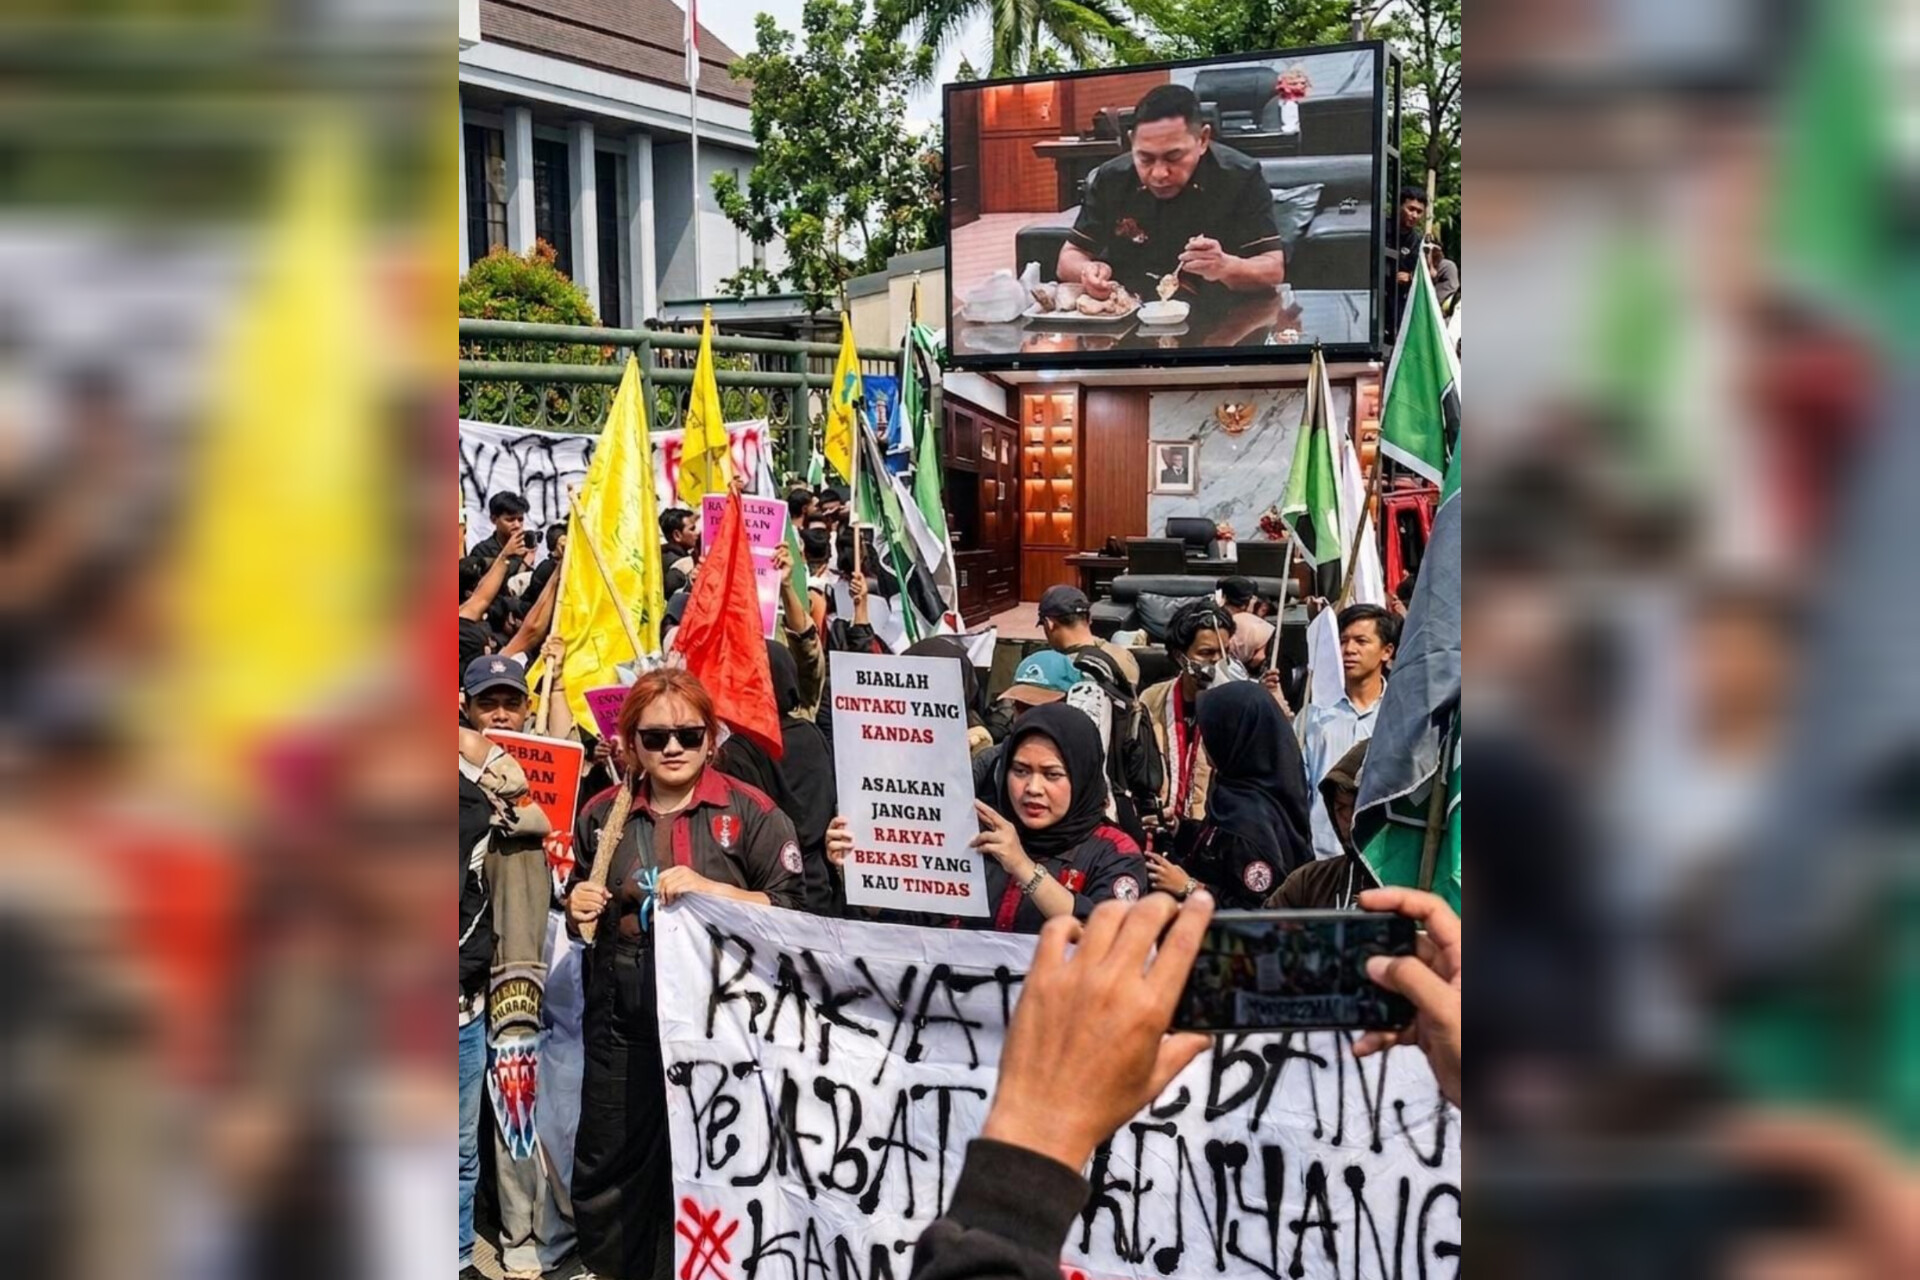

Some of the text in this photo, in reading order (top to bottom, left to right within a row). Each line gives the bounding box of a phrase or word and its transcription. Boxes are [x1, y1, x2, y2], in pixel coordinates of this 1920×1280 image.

[856, 670, 929, 689] BIARLAH
[835, 695, 960, 720] CINTAKU YANG
[861, 724, 934, 744] KANDAS
[861, 776, 945, 797] ASALKAN
[871, 802, 941, 822] JANGAN
[874, 827, 945, 847] RAKYAT
[854, 849, 971, 873] BEKASI YANG
[862, 874, 971, 898] KAU TINDAS
[704, 922, 1028, 1086] RAKYAT
